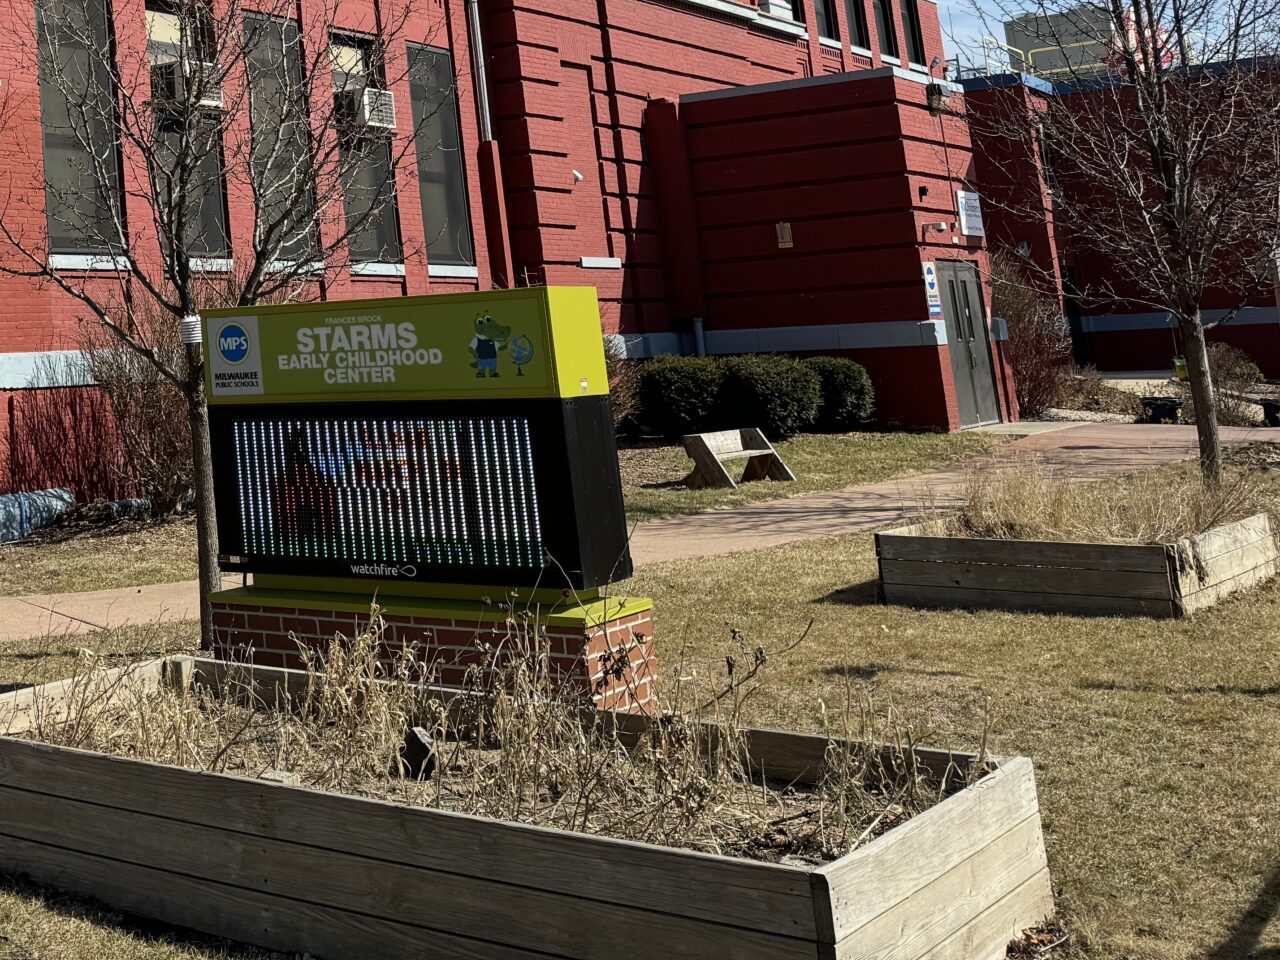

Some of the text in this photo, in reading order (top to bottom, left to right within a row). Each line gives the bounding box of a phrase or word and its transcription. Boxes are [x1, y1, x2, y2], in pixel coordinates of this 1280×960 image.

[325, 315, 383, 325] FRANCES BROCK
[219, 336, 248, 351] MPS
[296, 322, 418, 353] STARMS
[278, 348, 443, 370] EARLY CHILDHOOD
[215, 371, 259, 381] MILWAUKEE
[324, 367, 396, 384] CENTER
[215, 380, 259, 389] PUBLIC SCHOOLS
[350, 563, 398, 577] watchfire
